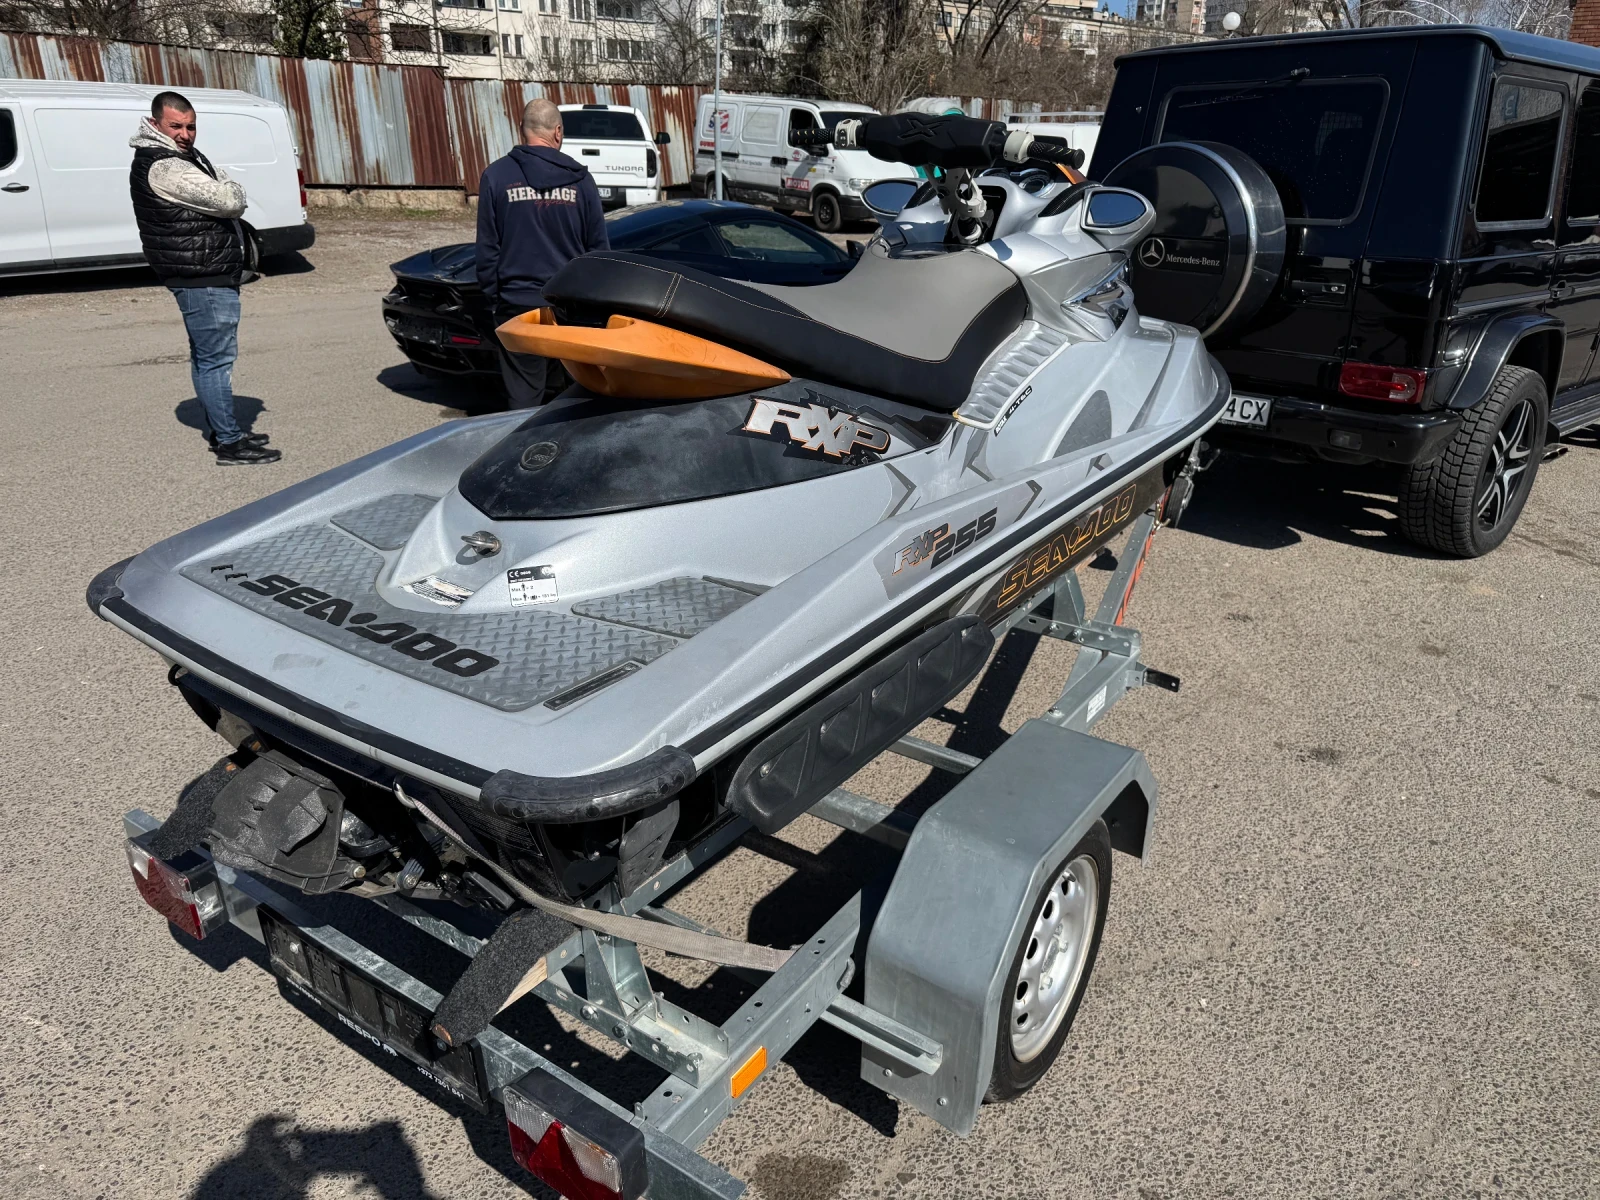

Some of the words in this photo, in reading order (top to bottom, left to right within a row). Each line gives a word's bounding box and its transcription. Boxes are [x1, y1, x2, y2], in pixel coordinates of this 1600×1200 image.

[786, 178, 808, 189] MOTUL
[1165, 253, 1221, 267] Mercedes-Benz
[741, 398, 892, 458] RXP
[891, 522, 950, 576] RXP
[930, 506, 998, 570] 255
[337, 1012, 381, 1047] RESPO
